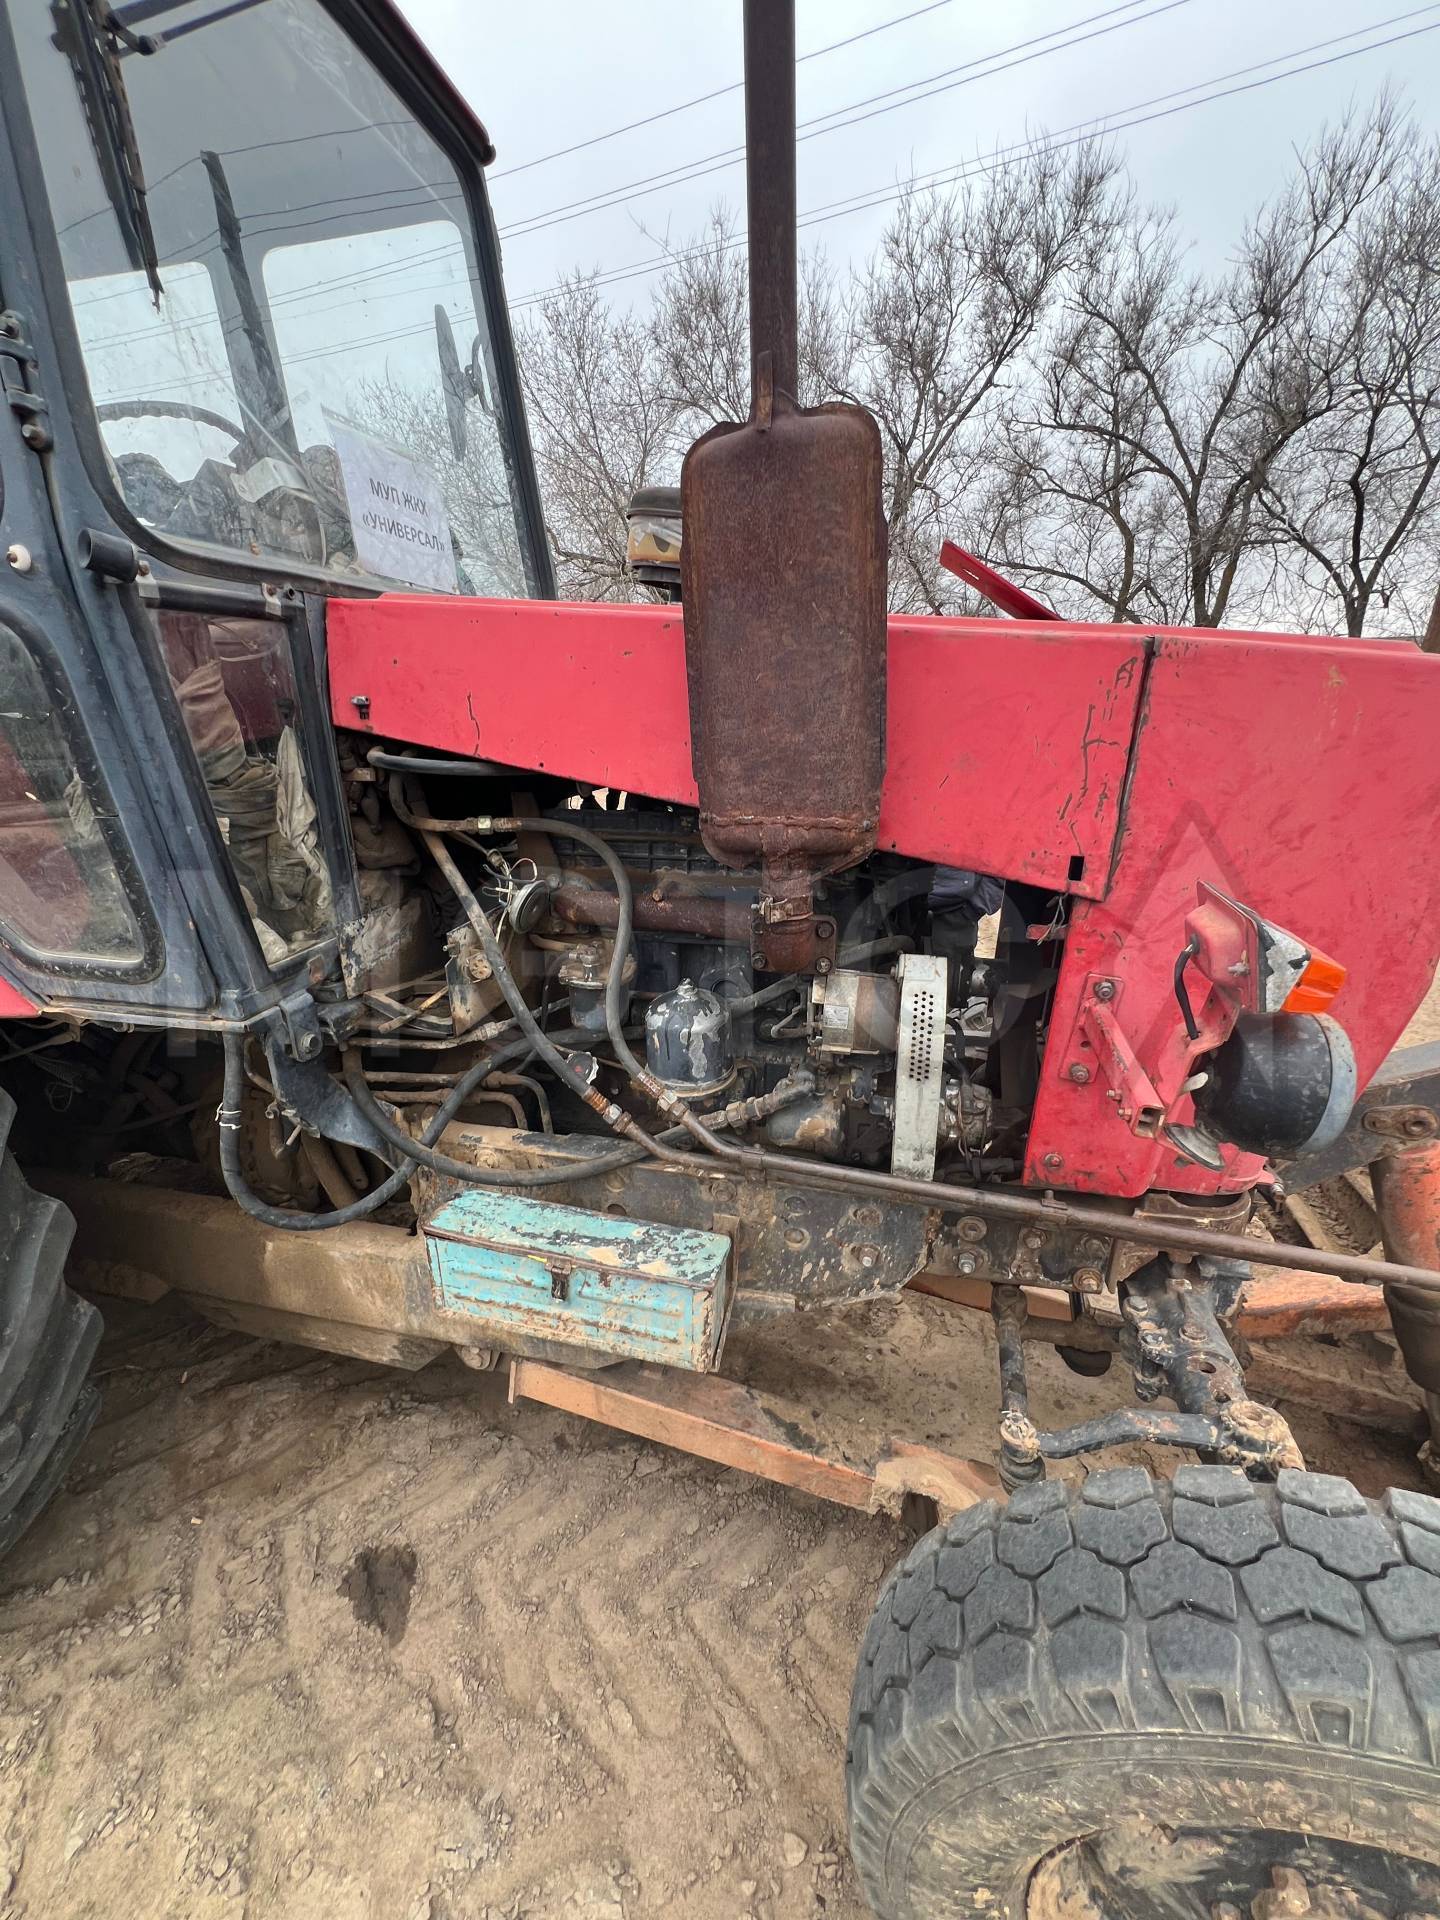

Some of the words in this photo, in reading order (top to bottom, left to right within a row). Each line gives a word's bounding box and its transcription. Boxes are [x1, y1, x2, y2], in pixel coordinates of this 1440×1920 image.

[369, 477, 400, 506] МУП
[402, 490, 428, 517] ЖКХ
[362, 511, 445, 552] «УНИВЕРСАЛ»
